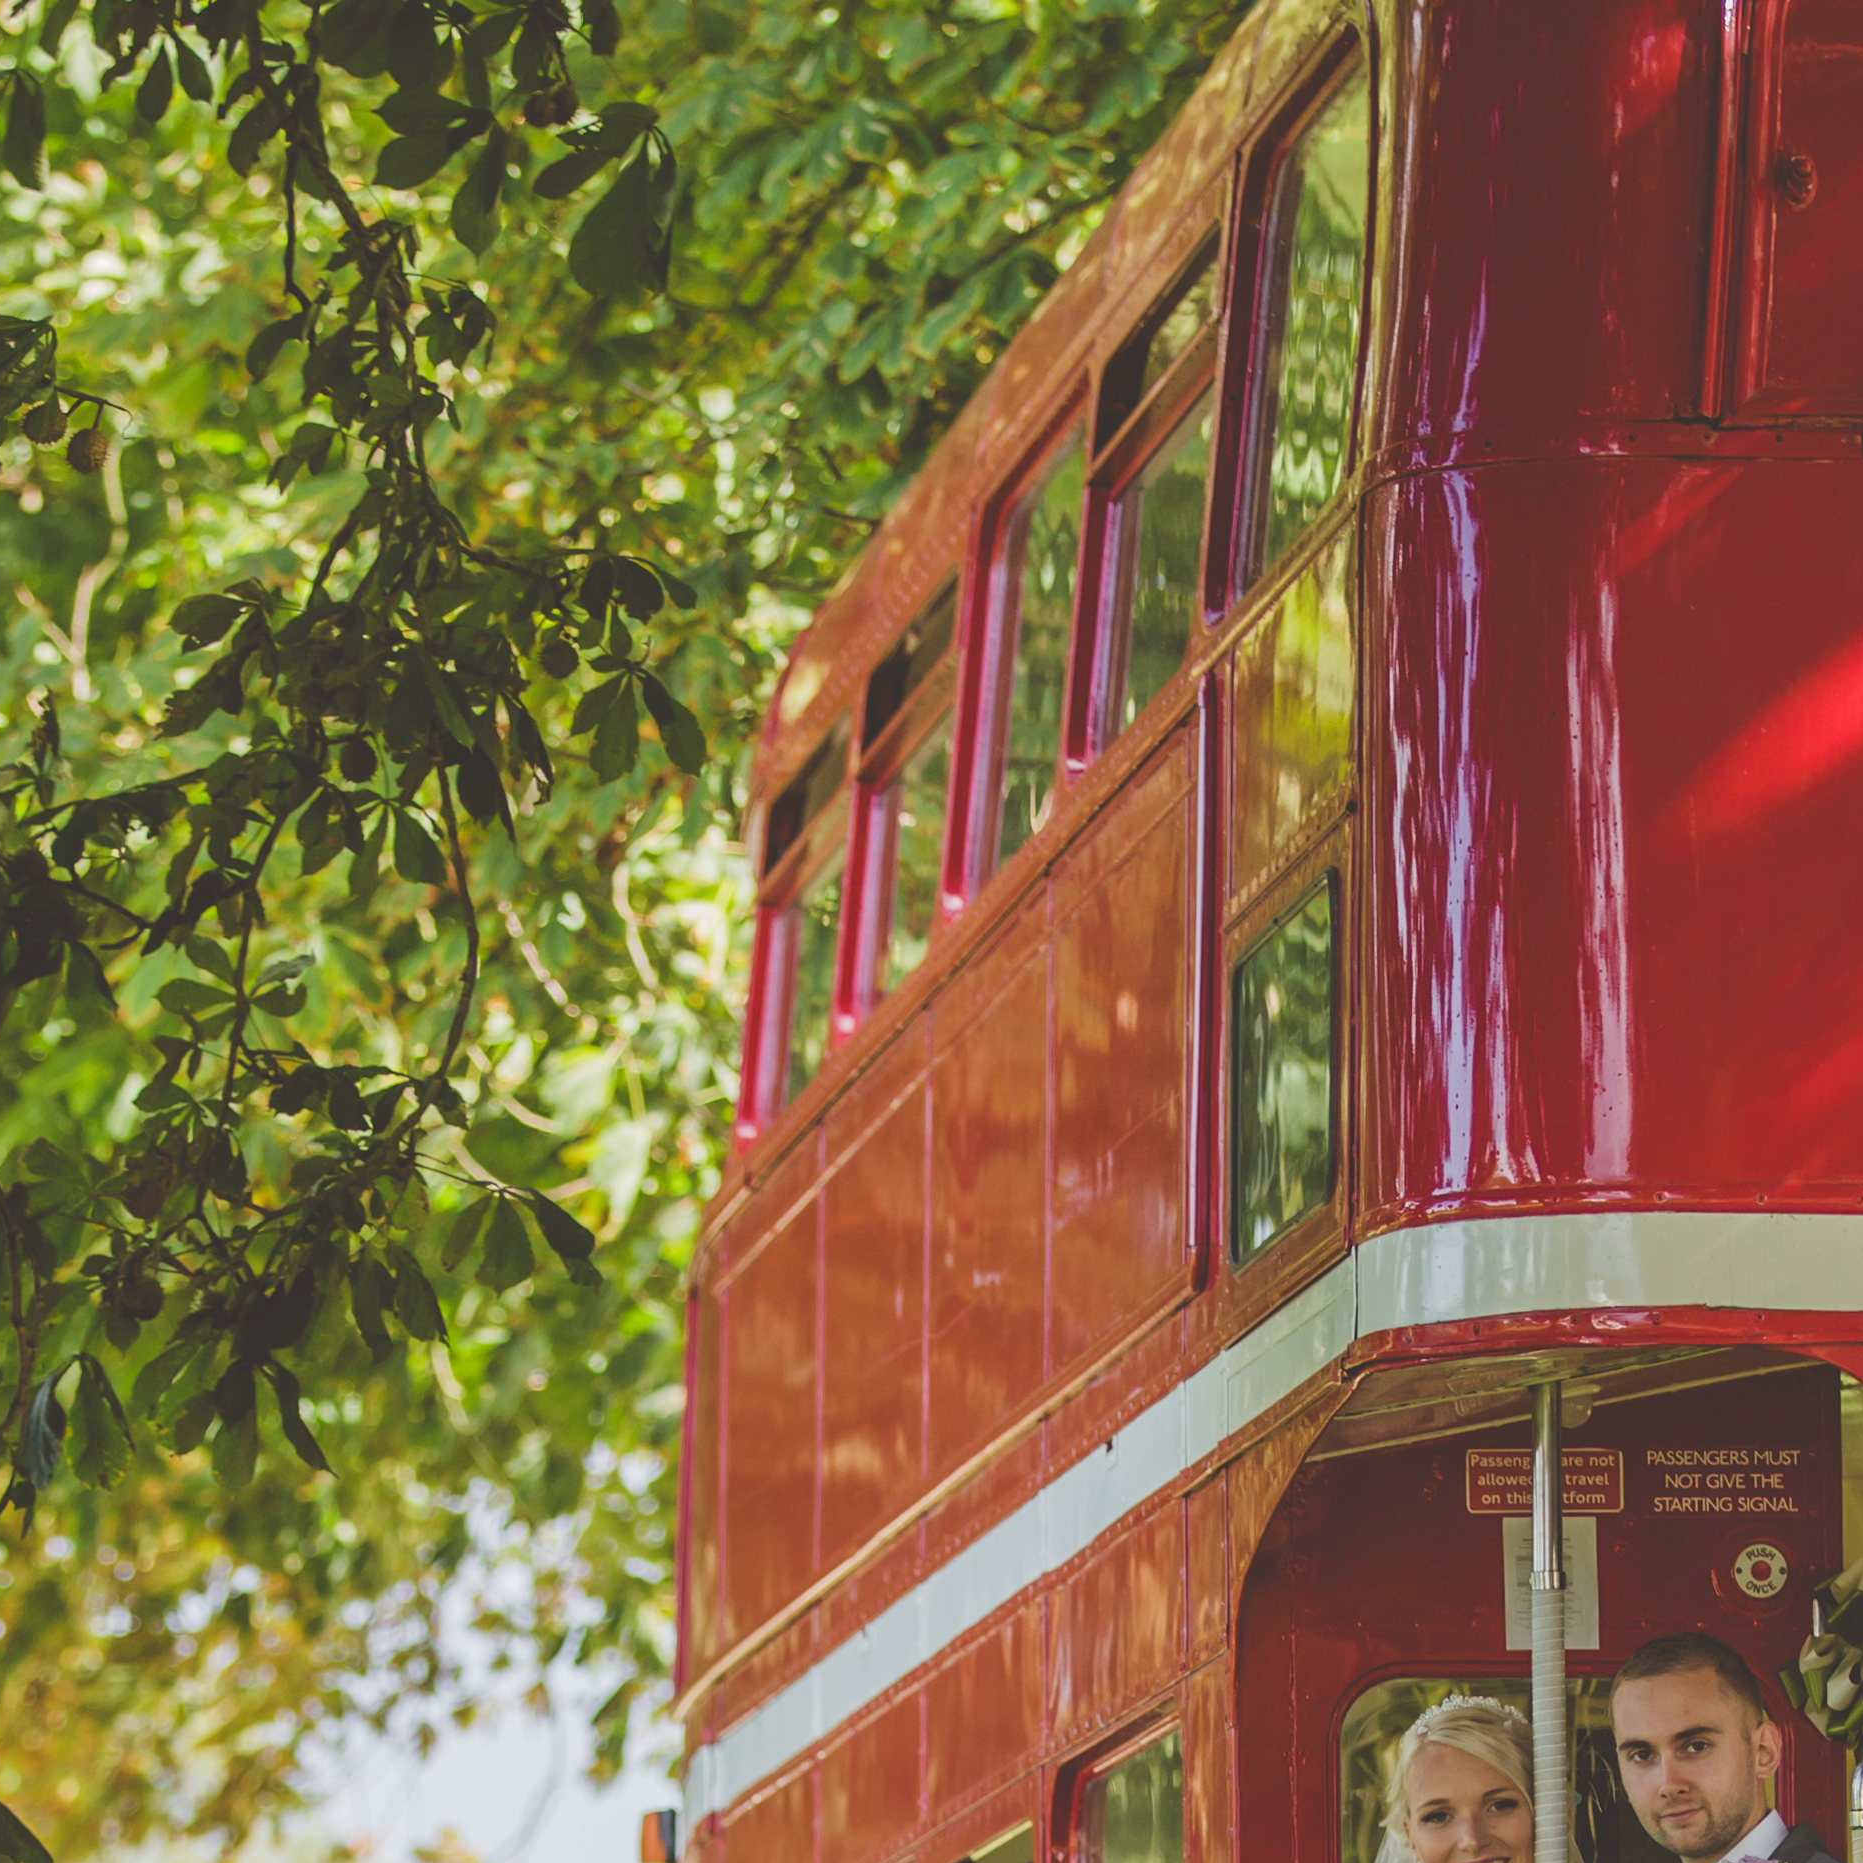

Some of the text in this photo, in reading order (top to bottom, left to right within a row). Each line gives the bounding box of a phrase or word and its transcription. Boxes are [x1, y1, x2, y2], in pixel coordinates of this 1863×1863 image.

[1470, 1453, 1615, 1471] Passeng are not
[1646, 1450, 1801, 1466] PASSENGERS MUST
[1565, 1472, 1609, 1486] travel
[1665, 1473, 1784, 1489] NOT GIVE THE
[1481, 1490, 1606, 1505] on this tform
[1654, 1496, 1799, 1512] STARTING SIGNAL
[1745, 1547, 1776, 1561] PUSH
[1745, 1580, 1777, 1594] ONCE
